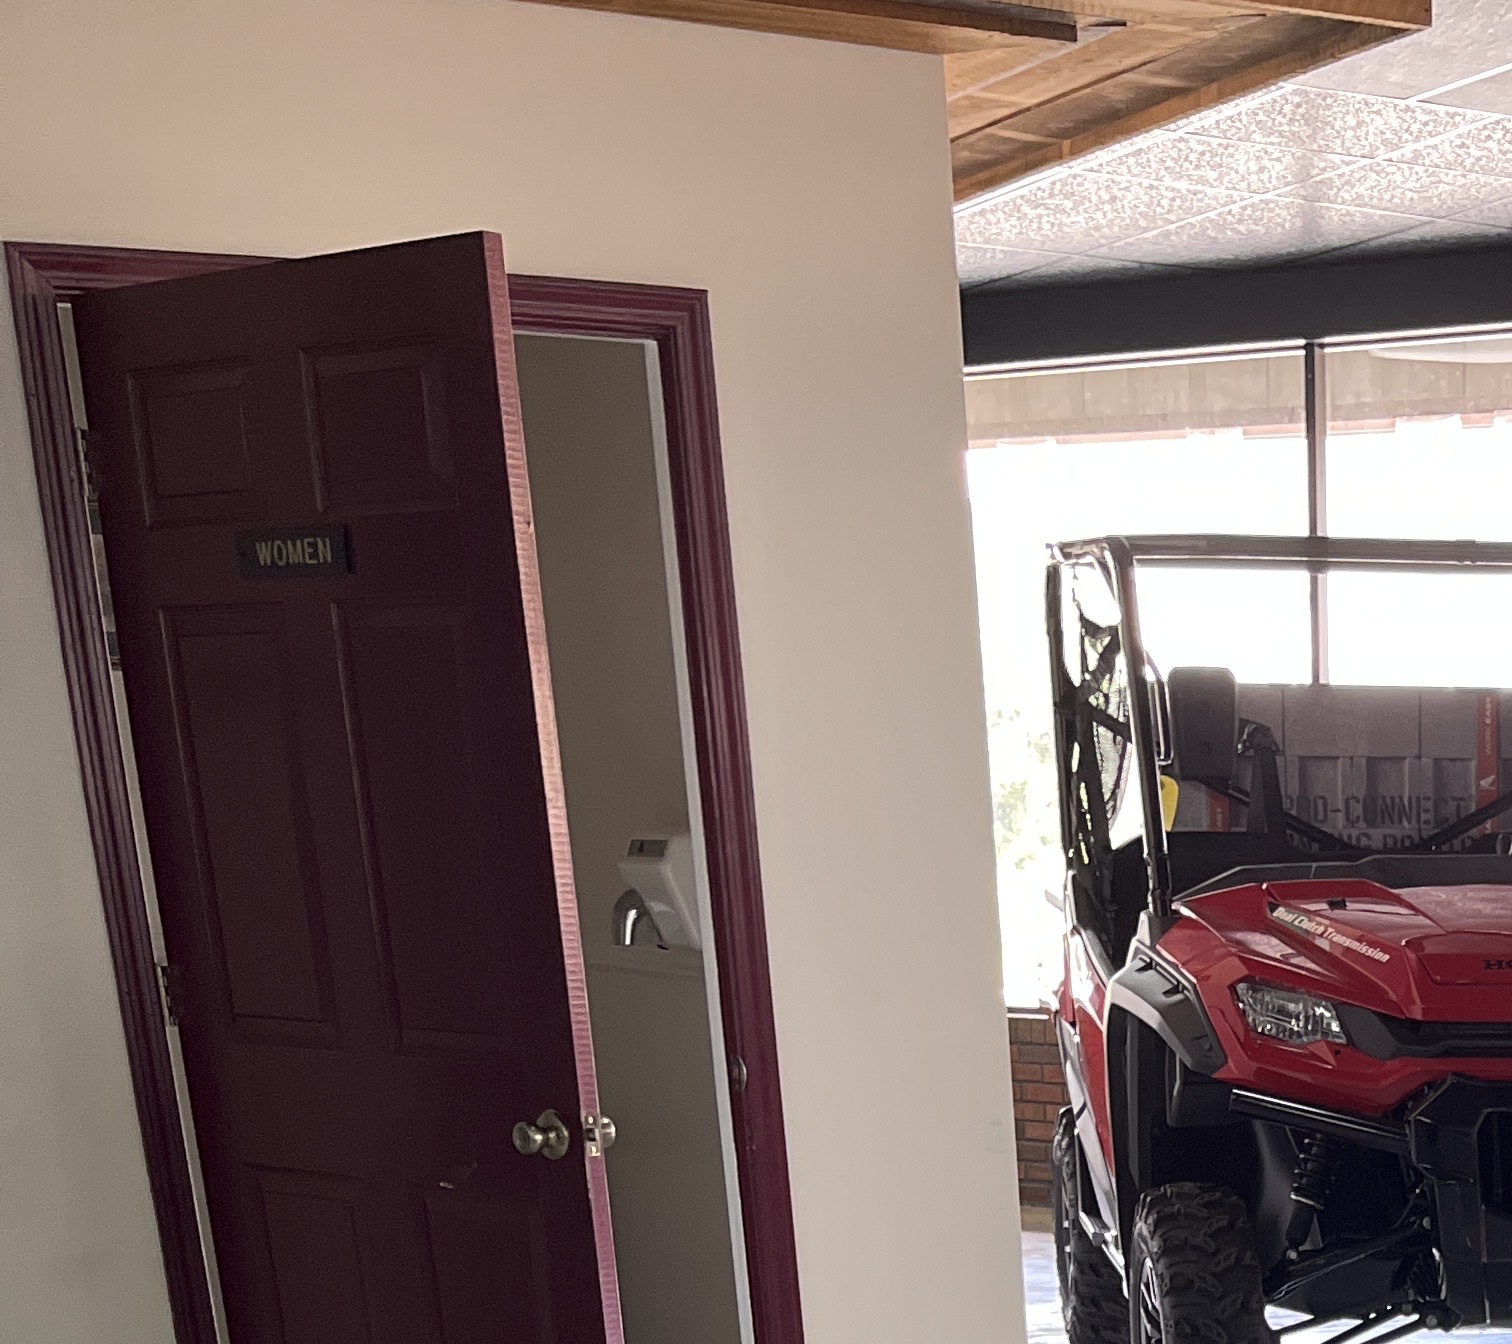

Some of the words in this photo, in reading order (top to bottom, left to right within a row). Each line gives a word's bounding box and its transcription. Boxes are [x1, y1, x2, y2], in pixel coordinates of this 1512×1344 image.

[255, 537, 332, 566] WOMEN
[1272, 906, 1297, 923] Dual
[1293, 916, 1325, 935] Clutch
[1323, 927, 1390, 963] Transmission
